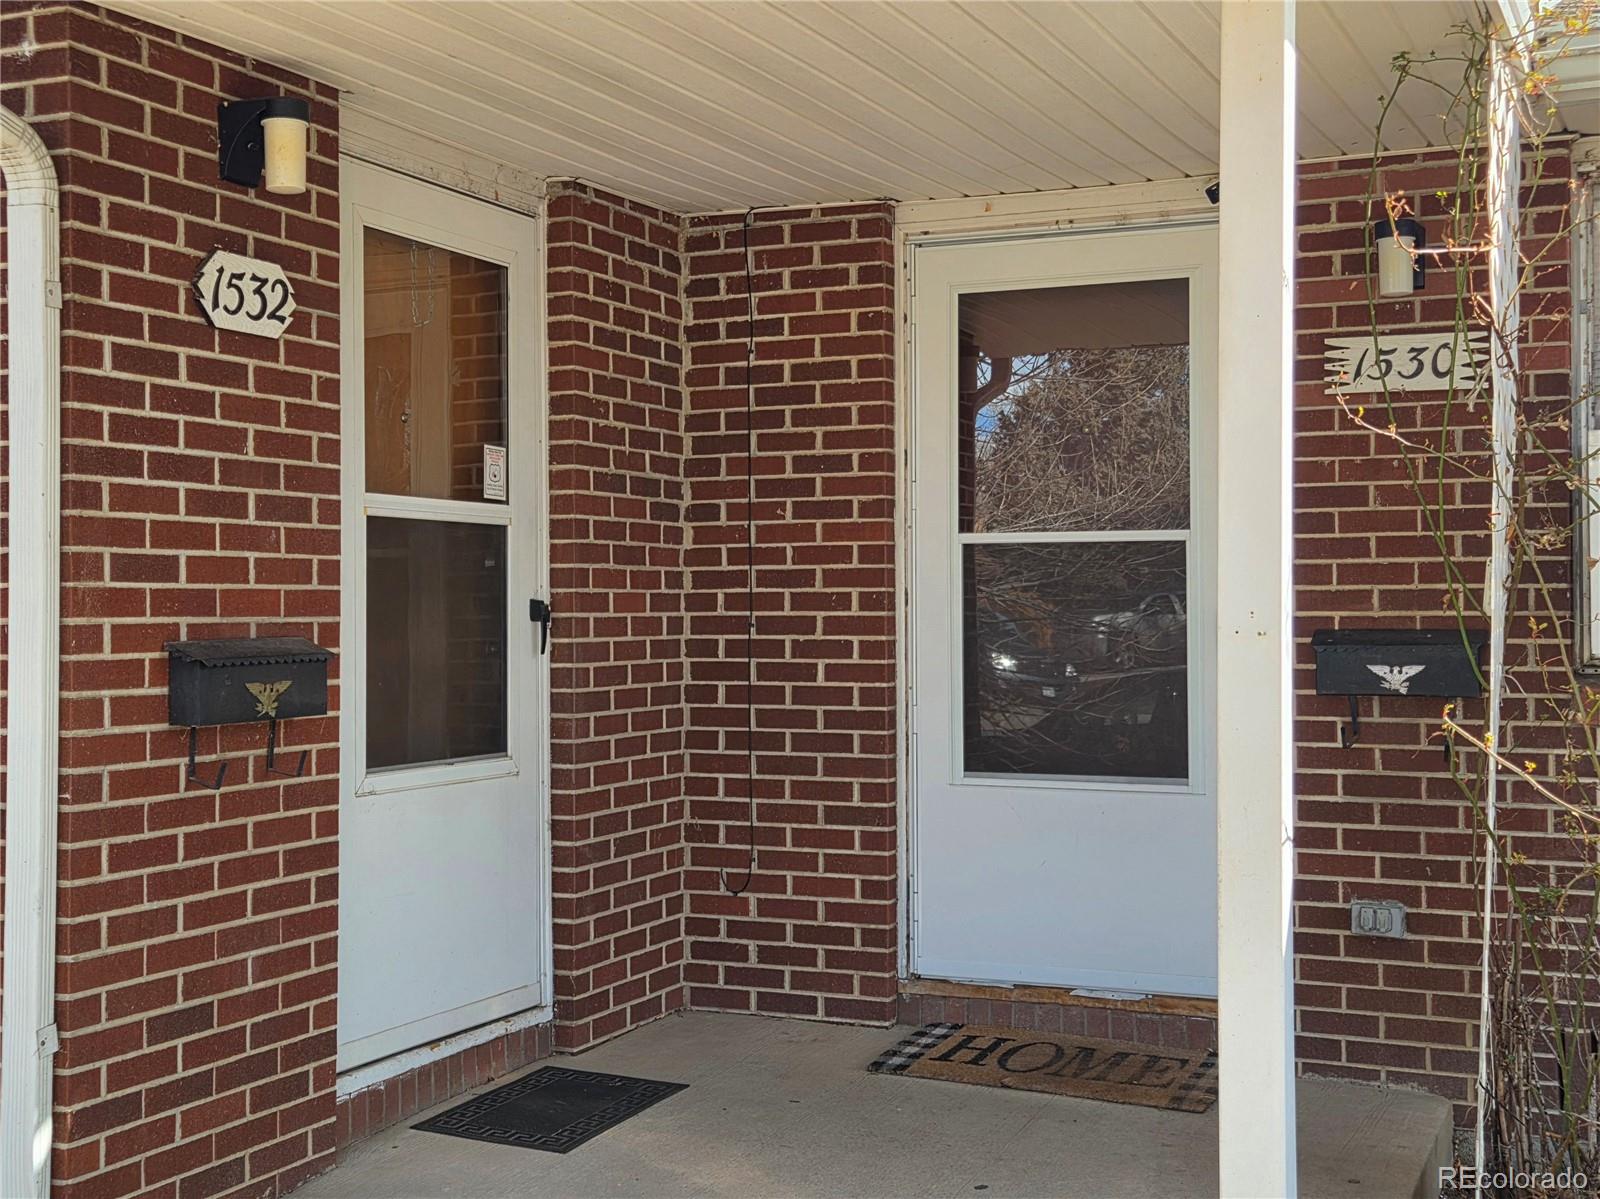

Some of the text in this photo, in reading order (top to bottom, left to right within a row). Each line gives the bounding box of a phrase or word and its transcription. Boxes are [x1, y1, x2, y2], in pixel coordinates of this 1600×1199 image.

[211, 265, 289, 325] 1532
[1353, 342, 1454, 383] 1530
[928, 1034, 1190, 1089] HOME
